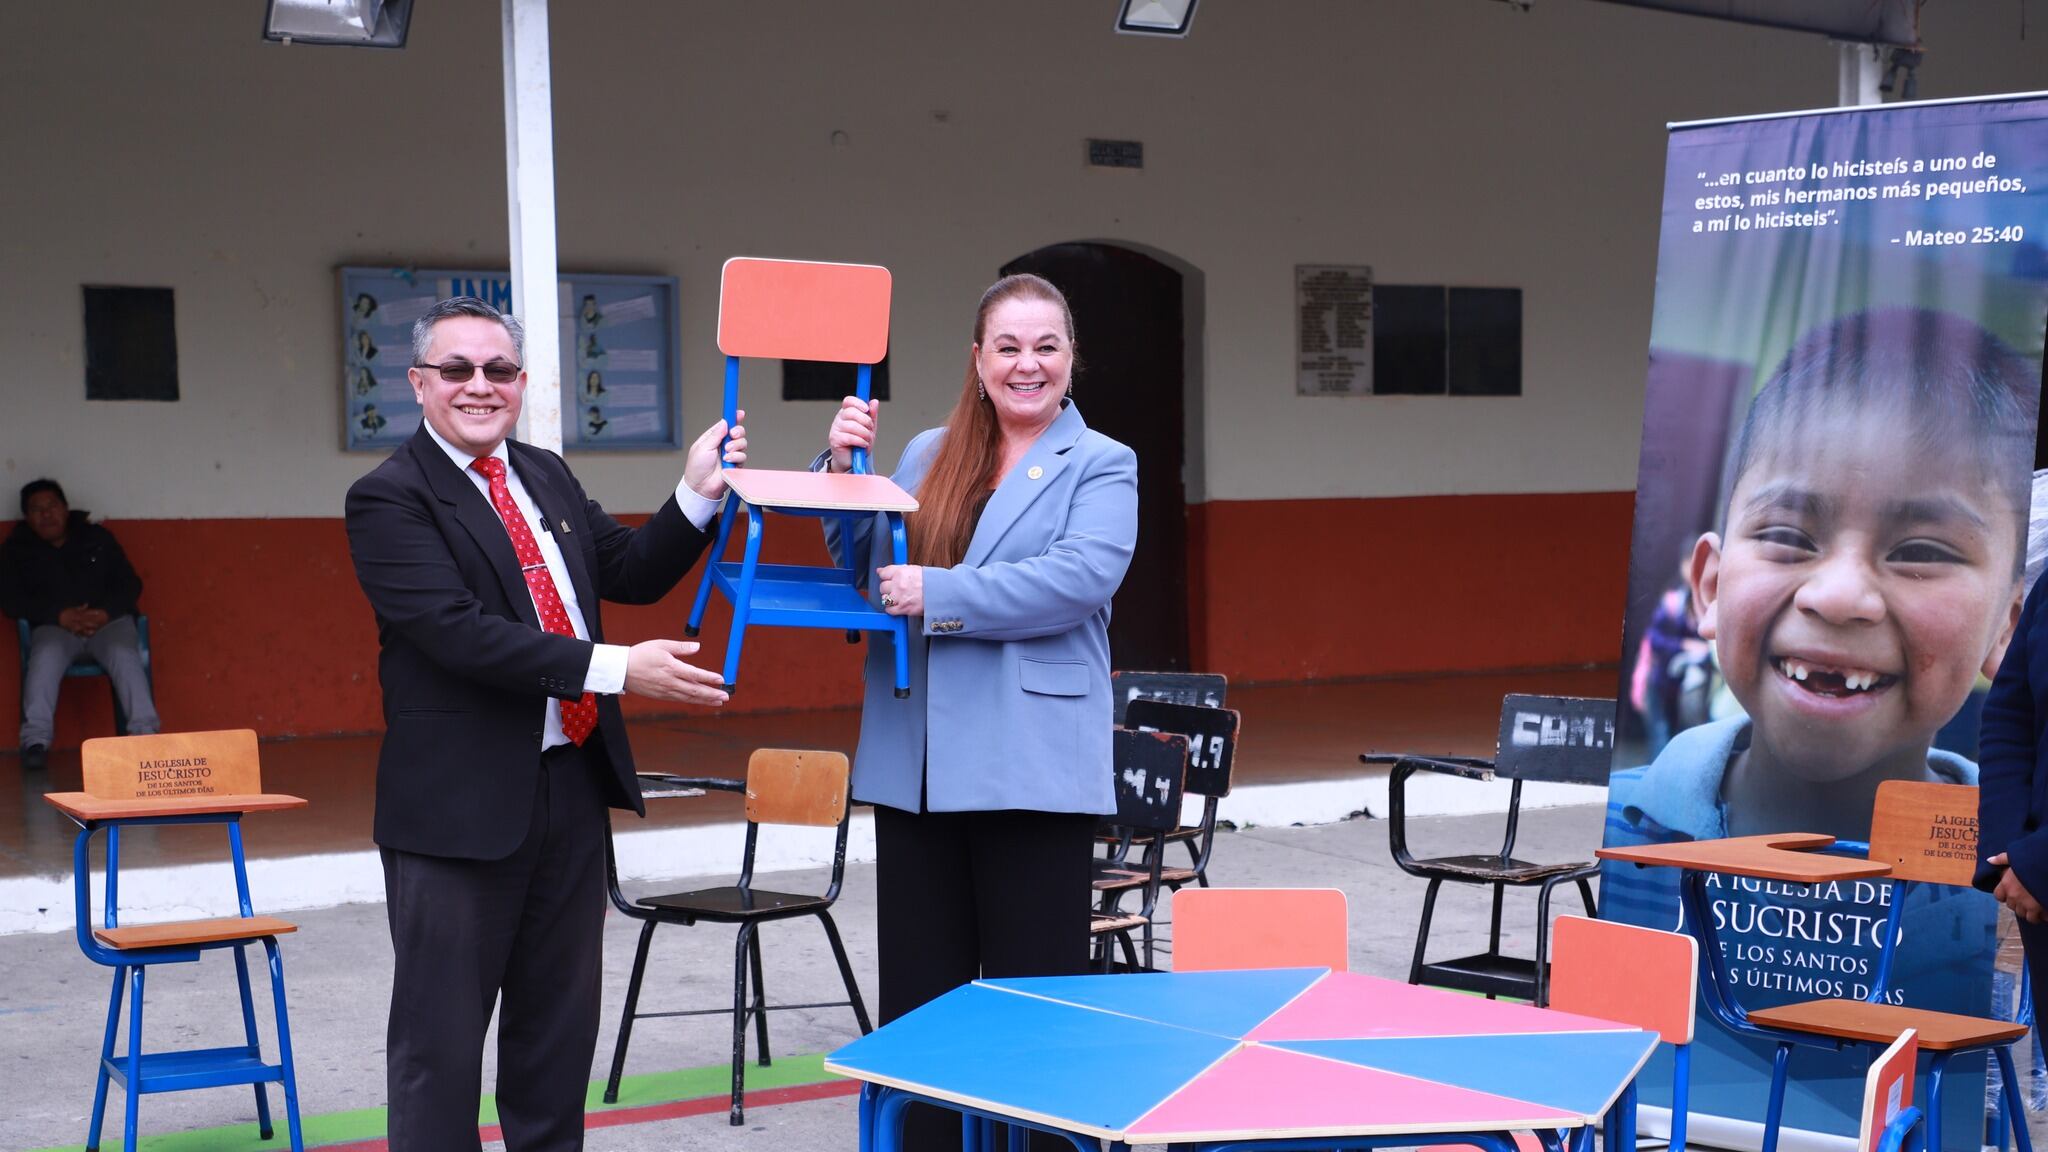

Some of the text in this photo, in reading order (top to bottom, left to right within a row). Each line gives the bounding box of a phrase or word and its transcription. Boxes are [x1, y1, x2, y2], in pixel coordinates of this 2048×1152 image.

[1745, 166, 1806, 184] cuanto
[1811, 163, 1829, 180] lo
[1832, 157, 1908, 178] hicisteís
[1913, 159, 1924, 172] a
[1930, 156, 1967, 171] uno
[1972, 152, 1996, 168] de
[1695, 176, 2027, 210] estos, mis hermanos más pequeños,
[1692, 220, 1703, 232] a
[1708, 215, 1731, 231] mí
[1734, 215, 1751, 231] lo
[1905, 230, 1967, 246] Mateo
[1971, 225, 2023, 243] 25:40
[140, 757, 207, 769] LA IGLESIA DE
[138, 767, 211, 783] JESUCRISTO
[174, 779, 203, 787] SANTOS
[148, 789, 162, 797] LOS
[163, 786, 197, 796] ÚLTIMOS
[197, 785, 215, 794] DÍAS
[1935, 814, 1948, 825] LA
[1929, 826, 1979, 842] JESUCR
[1924, 849, 1935, 857] DE
[1937, 850, 1952, 858] LOS
[1938, 841, 1950, 849] DE
[1952, 842, 1966, 850] LOS
[1705, 872, 1722, 889] A
[1854, 881, 1892, 907] DE
[1672, 896, 1903, 949] JSUCRISTO
[1737, 943, 1775, 964] LOS
[1782, 949, 1869, 975] SANTOS
[1747, 967, 1844, 998] ÚLTIMOS
